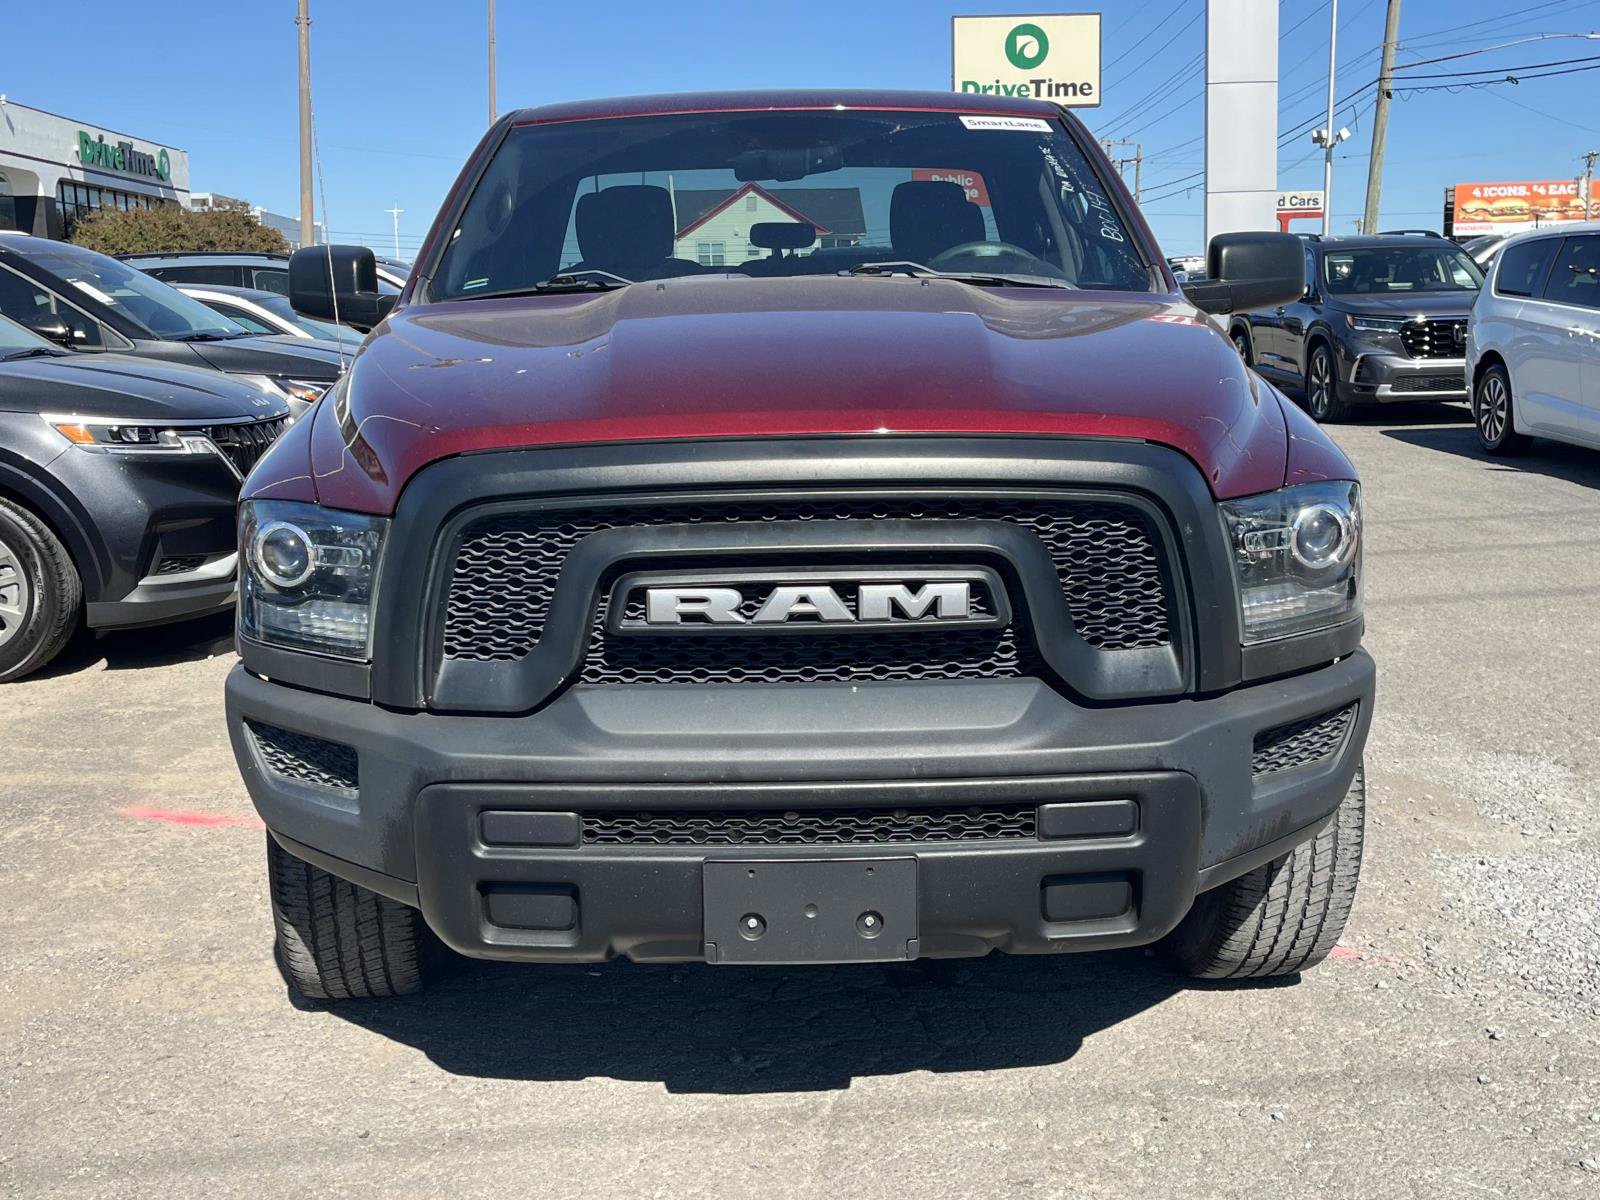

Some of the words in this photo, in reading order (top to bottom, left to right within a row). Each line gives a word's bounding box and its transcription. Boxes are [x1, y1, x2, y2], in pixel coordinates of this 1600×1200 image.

[961, 78, 1093, 98] DriveTime
[78, 130, 156, 176] DriveTime
[1472, 187, 1482, 197] 4
[1484, 185, 1531, 197] ICONS.
[1548, 183, 1579, 195] EAC
[1290, 196, 1319, 206] Cars
[646, 581, 971, 624] RAM
